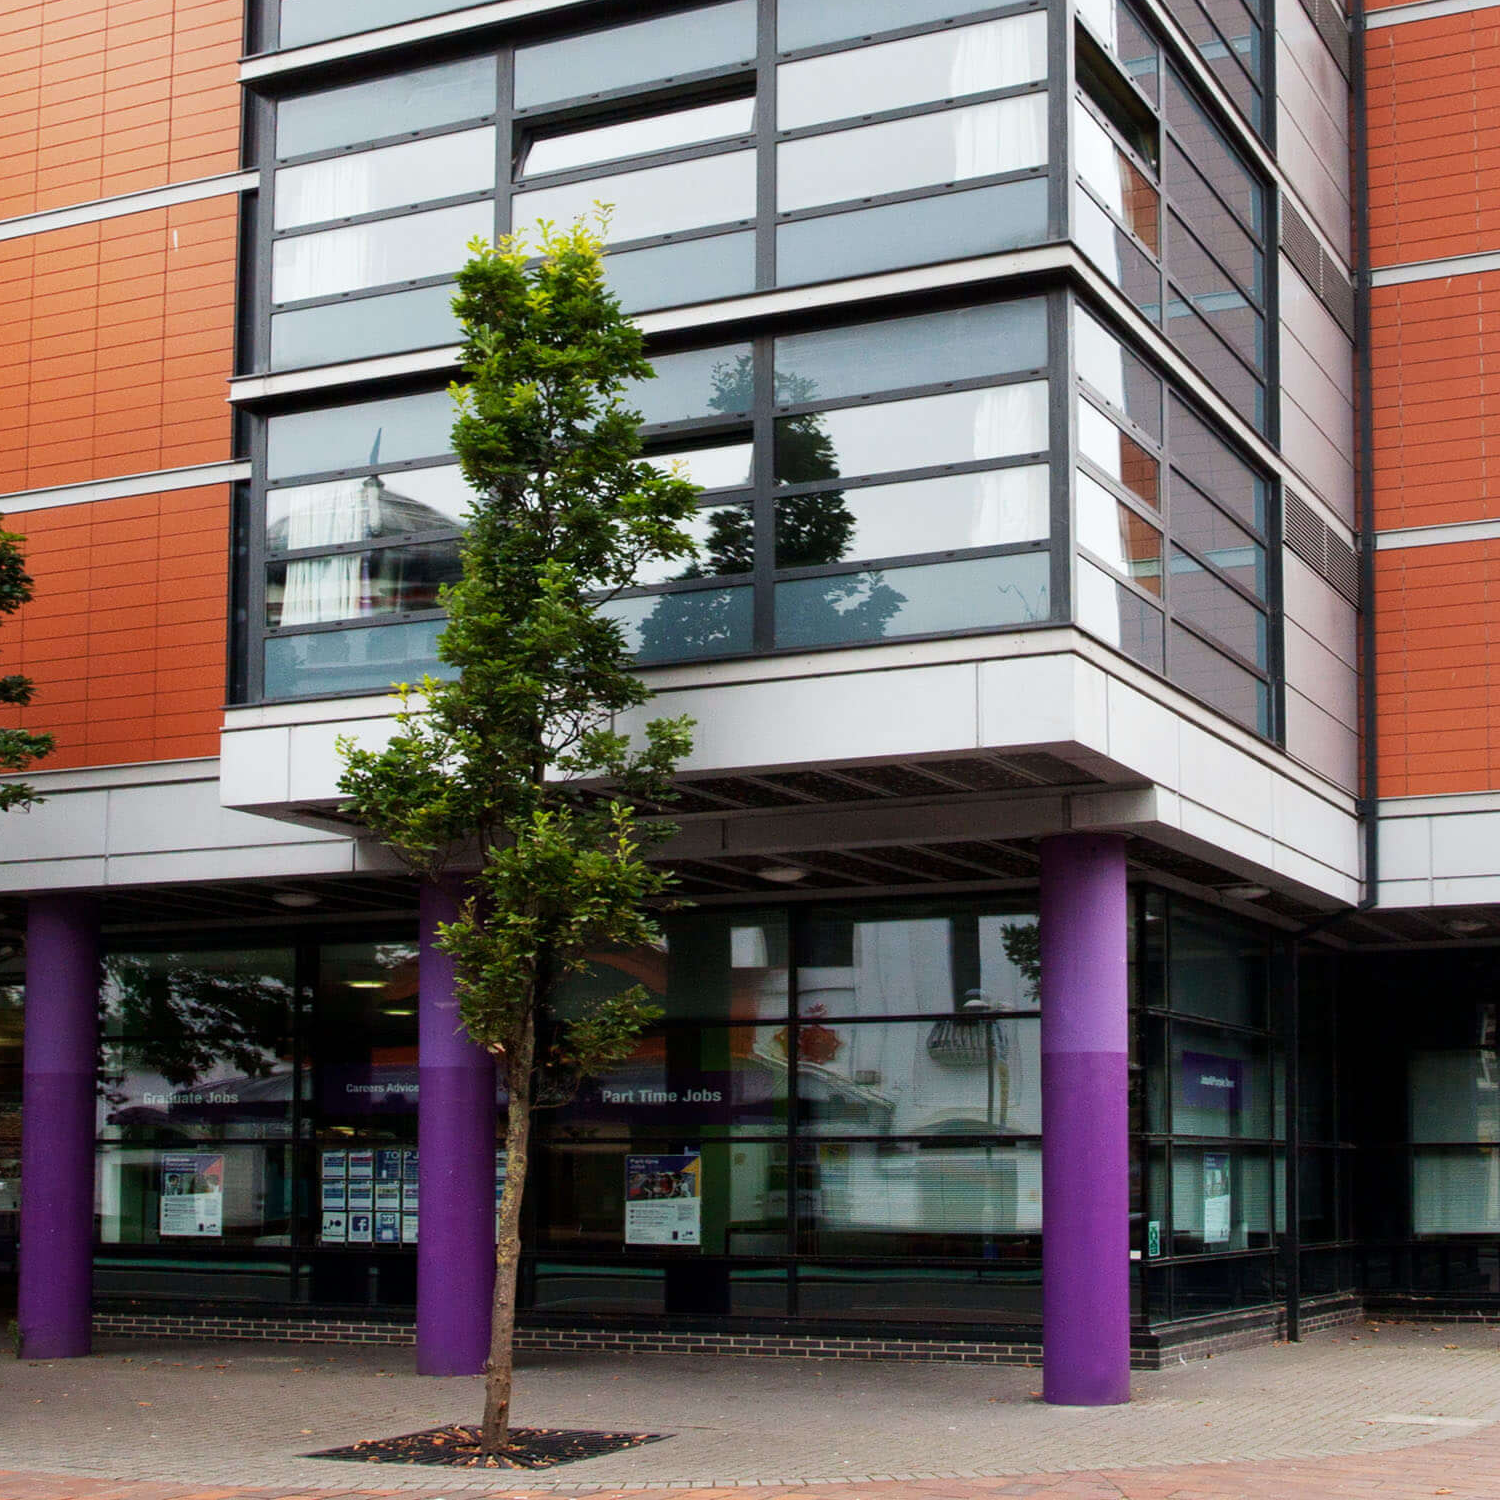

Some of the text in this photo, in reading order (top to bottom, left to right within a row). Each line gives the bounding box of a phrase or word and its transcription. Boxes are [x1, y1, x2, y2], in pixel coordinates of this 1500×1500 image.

[346, 1083, 384, 1093] Careers
[143, 1091, 239, 1104] Graduate Jobs
[602, 1088, 722, 1103] Part Time Jobs
